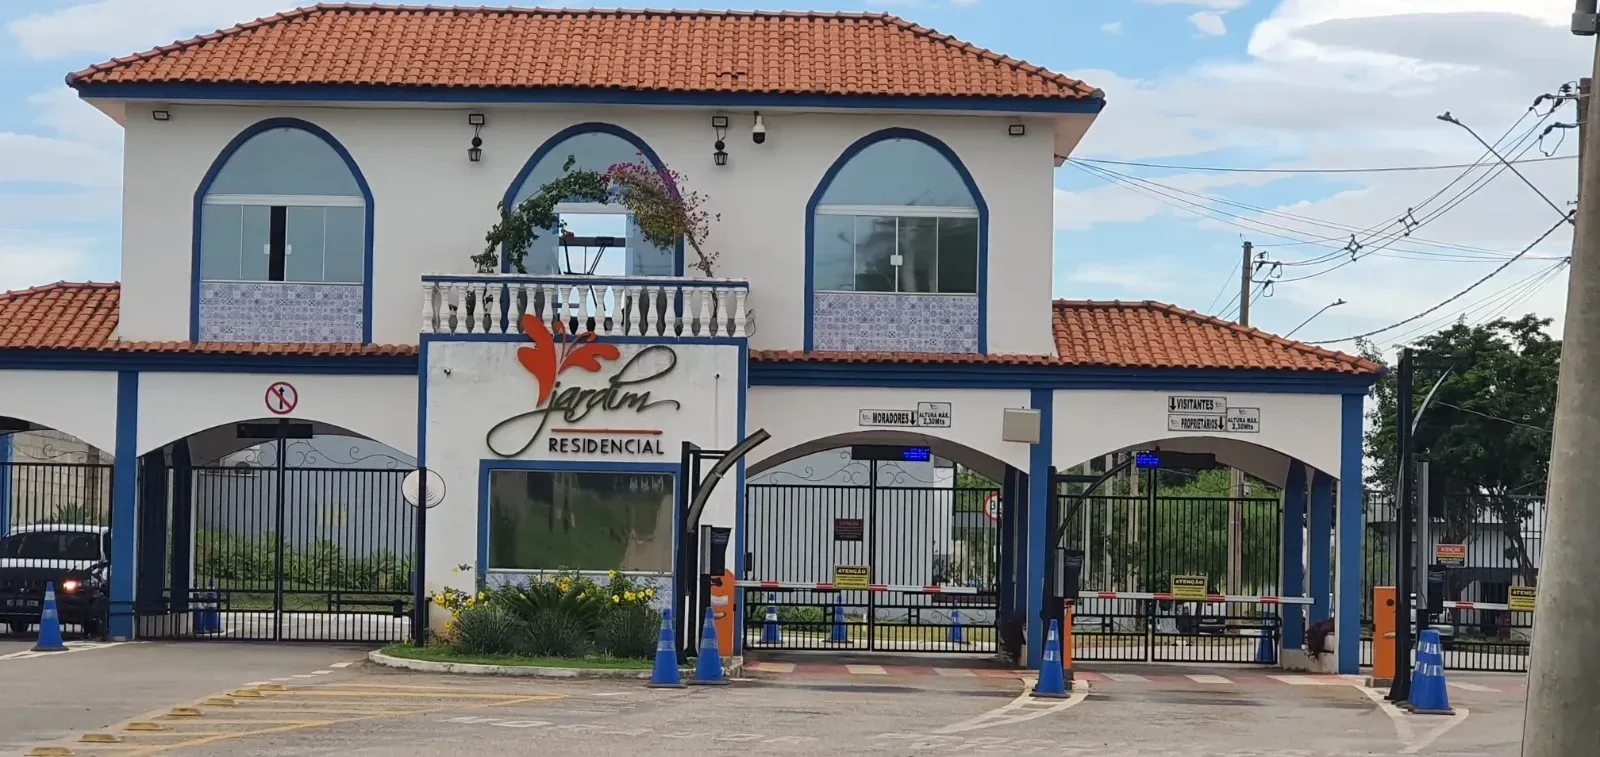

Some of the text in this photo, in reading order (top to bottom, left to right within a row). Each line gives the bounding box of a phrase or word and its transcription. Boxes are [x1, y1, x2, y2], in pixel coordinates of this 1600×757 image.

[1177, 398, 1213, 410] VISITANTES
[872, 412, 909, 424] MORADORES
[1181, 416, 1218, 429] PROPRIETÁRIOS
[548, 438, 665, 455] RESIDENCIAL
